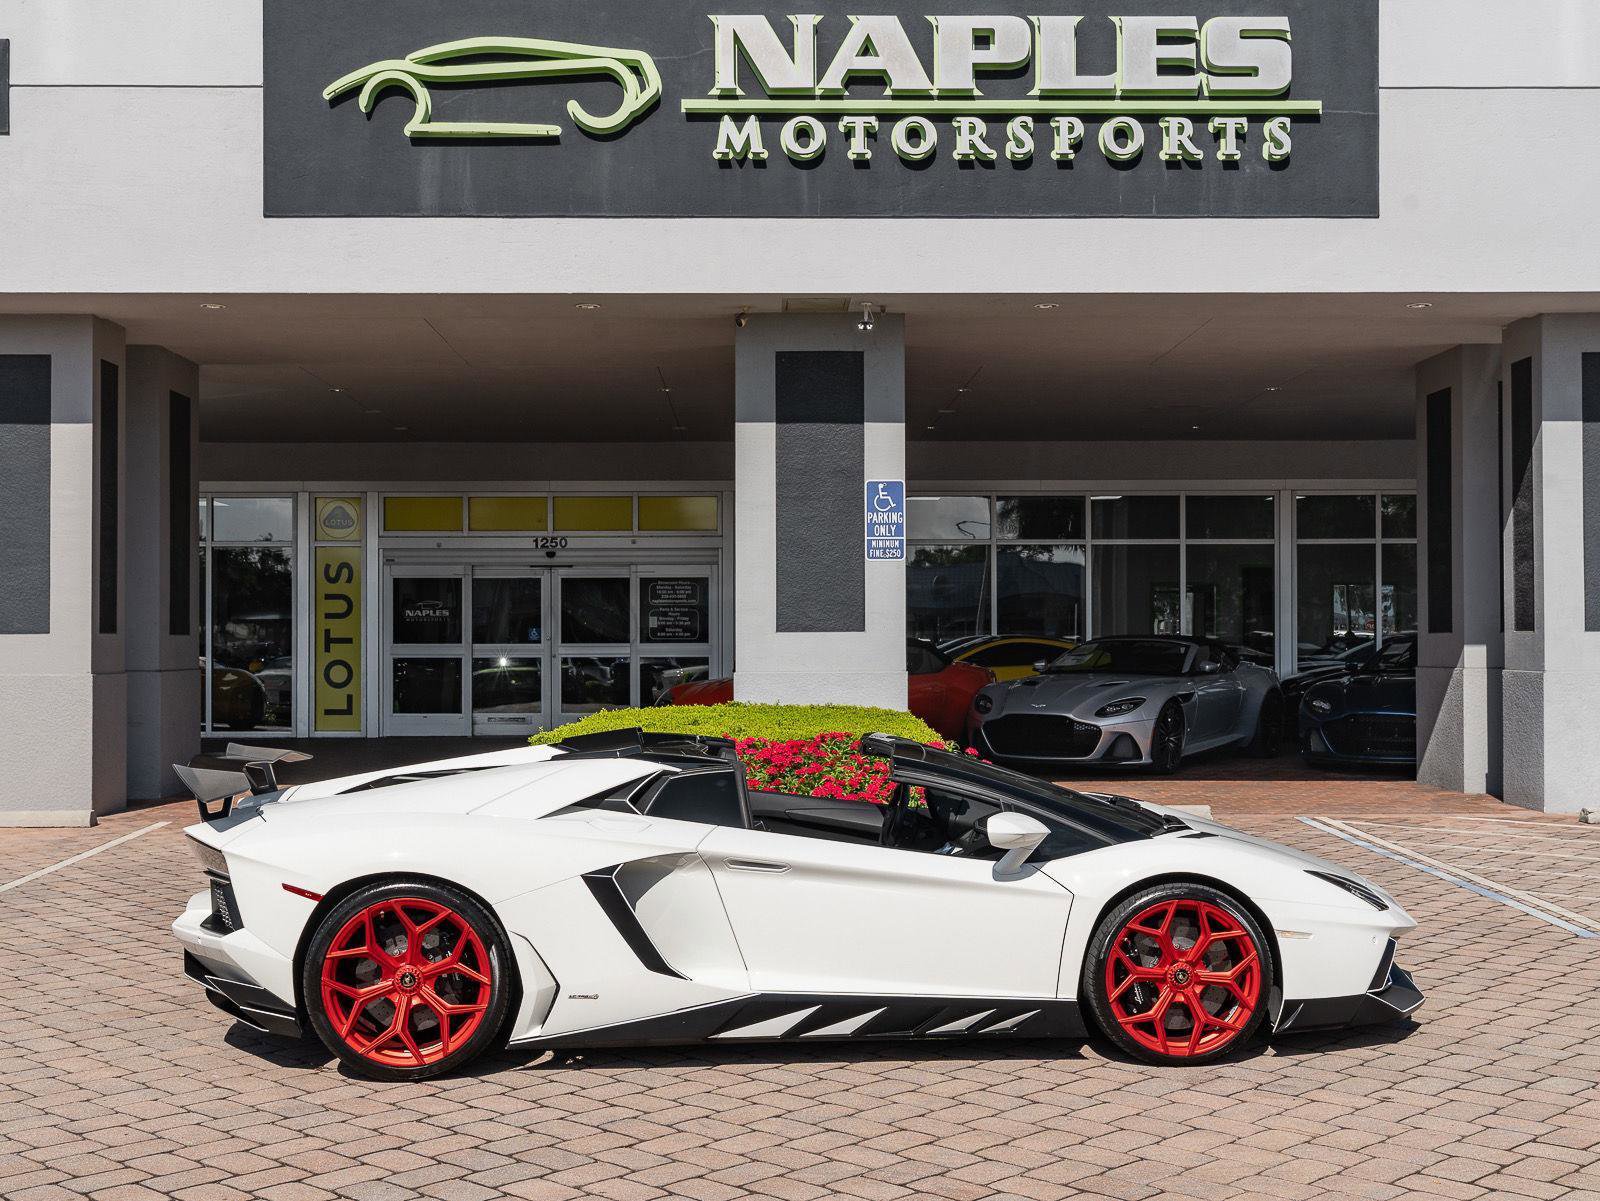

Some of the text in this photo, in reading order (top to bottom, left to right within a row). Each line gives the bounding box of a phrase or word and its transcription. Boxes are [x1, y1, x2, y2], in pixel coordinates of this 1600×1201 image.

[707, 14, 1293, 98] NAPLES
[712, 114, 1292, 162] MOTORSPORTS
[325, 519, 354, 527] LOTUS
[867, 512, 903, 524] PARKING
[874, 525, 896, 536] ONLY
[533, 536, 568, 549] 1250
[871, 540, 900, 548] MINIMUM
[869, 549, 901, 558] FINE $250
[324, 562, 354, 716] LOTUS
